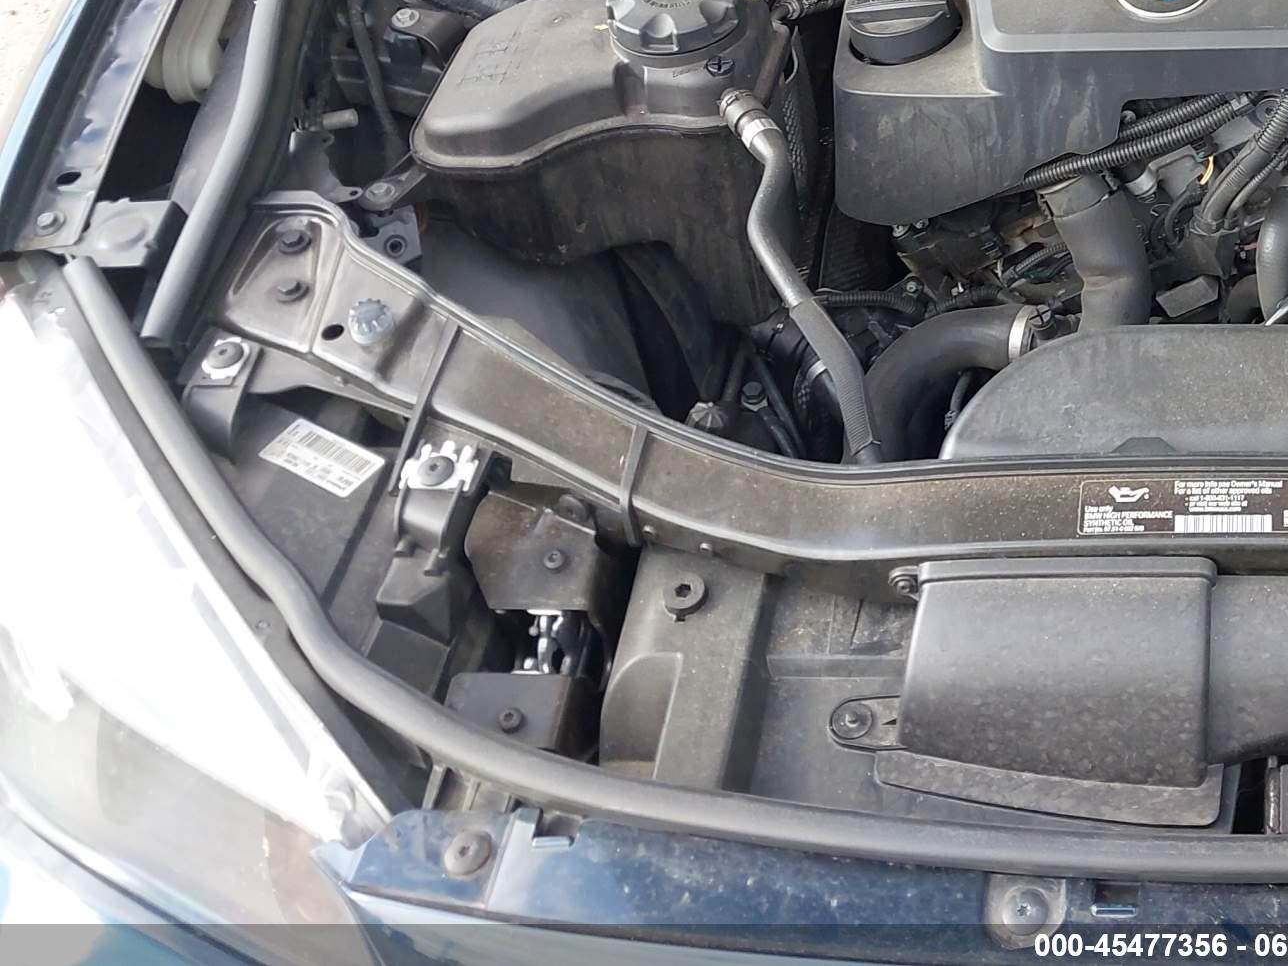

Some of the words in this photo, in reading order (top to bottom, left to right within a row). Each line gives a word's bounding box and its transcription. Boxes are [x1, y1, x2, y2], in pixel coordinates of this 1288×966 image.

[1204, 480, 1218, 488] info
[1230, 480, 1258, 488] Owner's
[1258, 480, 1283, 488] Manual
[1174, 487, 1186, 495] For
[1229, 487, 1260, 495] approved
[1098, 505, 1114, 513] only
[1103, 511, 1121, 519] HIGH
[1121, 510, 1174, 519] PERFORMANCE
[1083, 518, 1122, 526] SYNTHETIC
[1122, 518, 1135, 526] OIL
